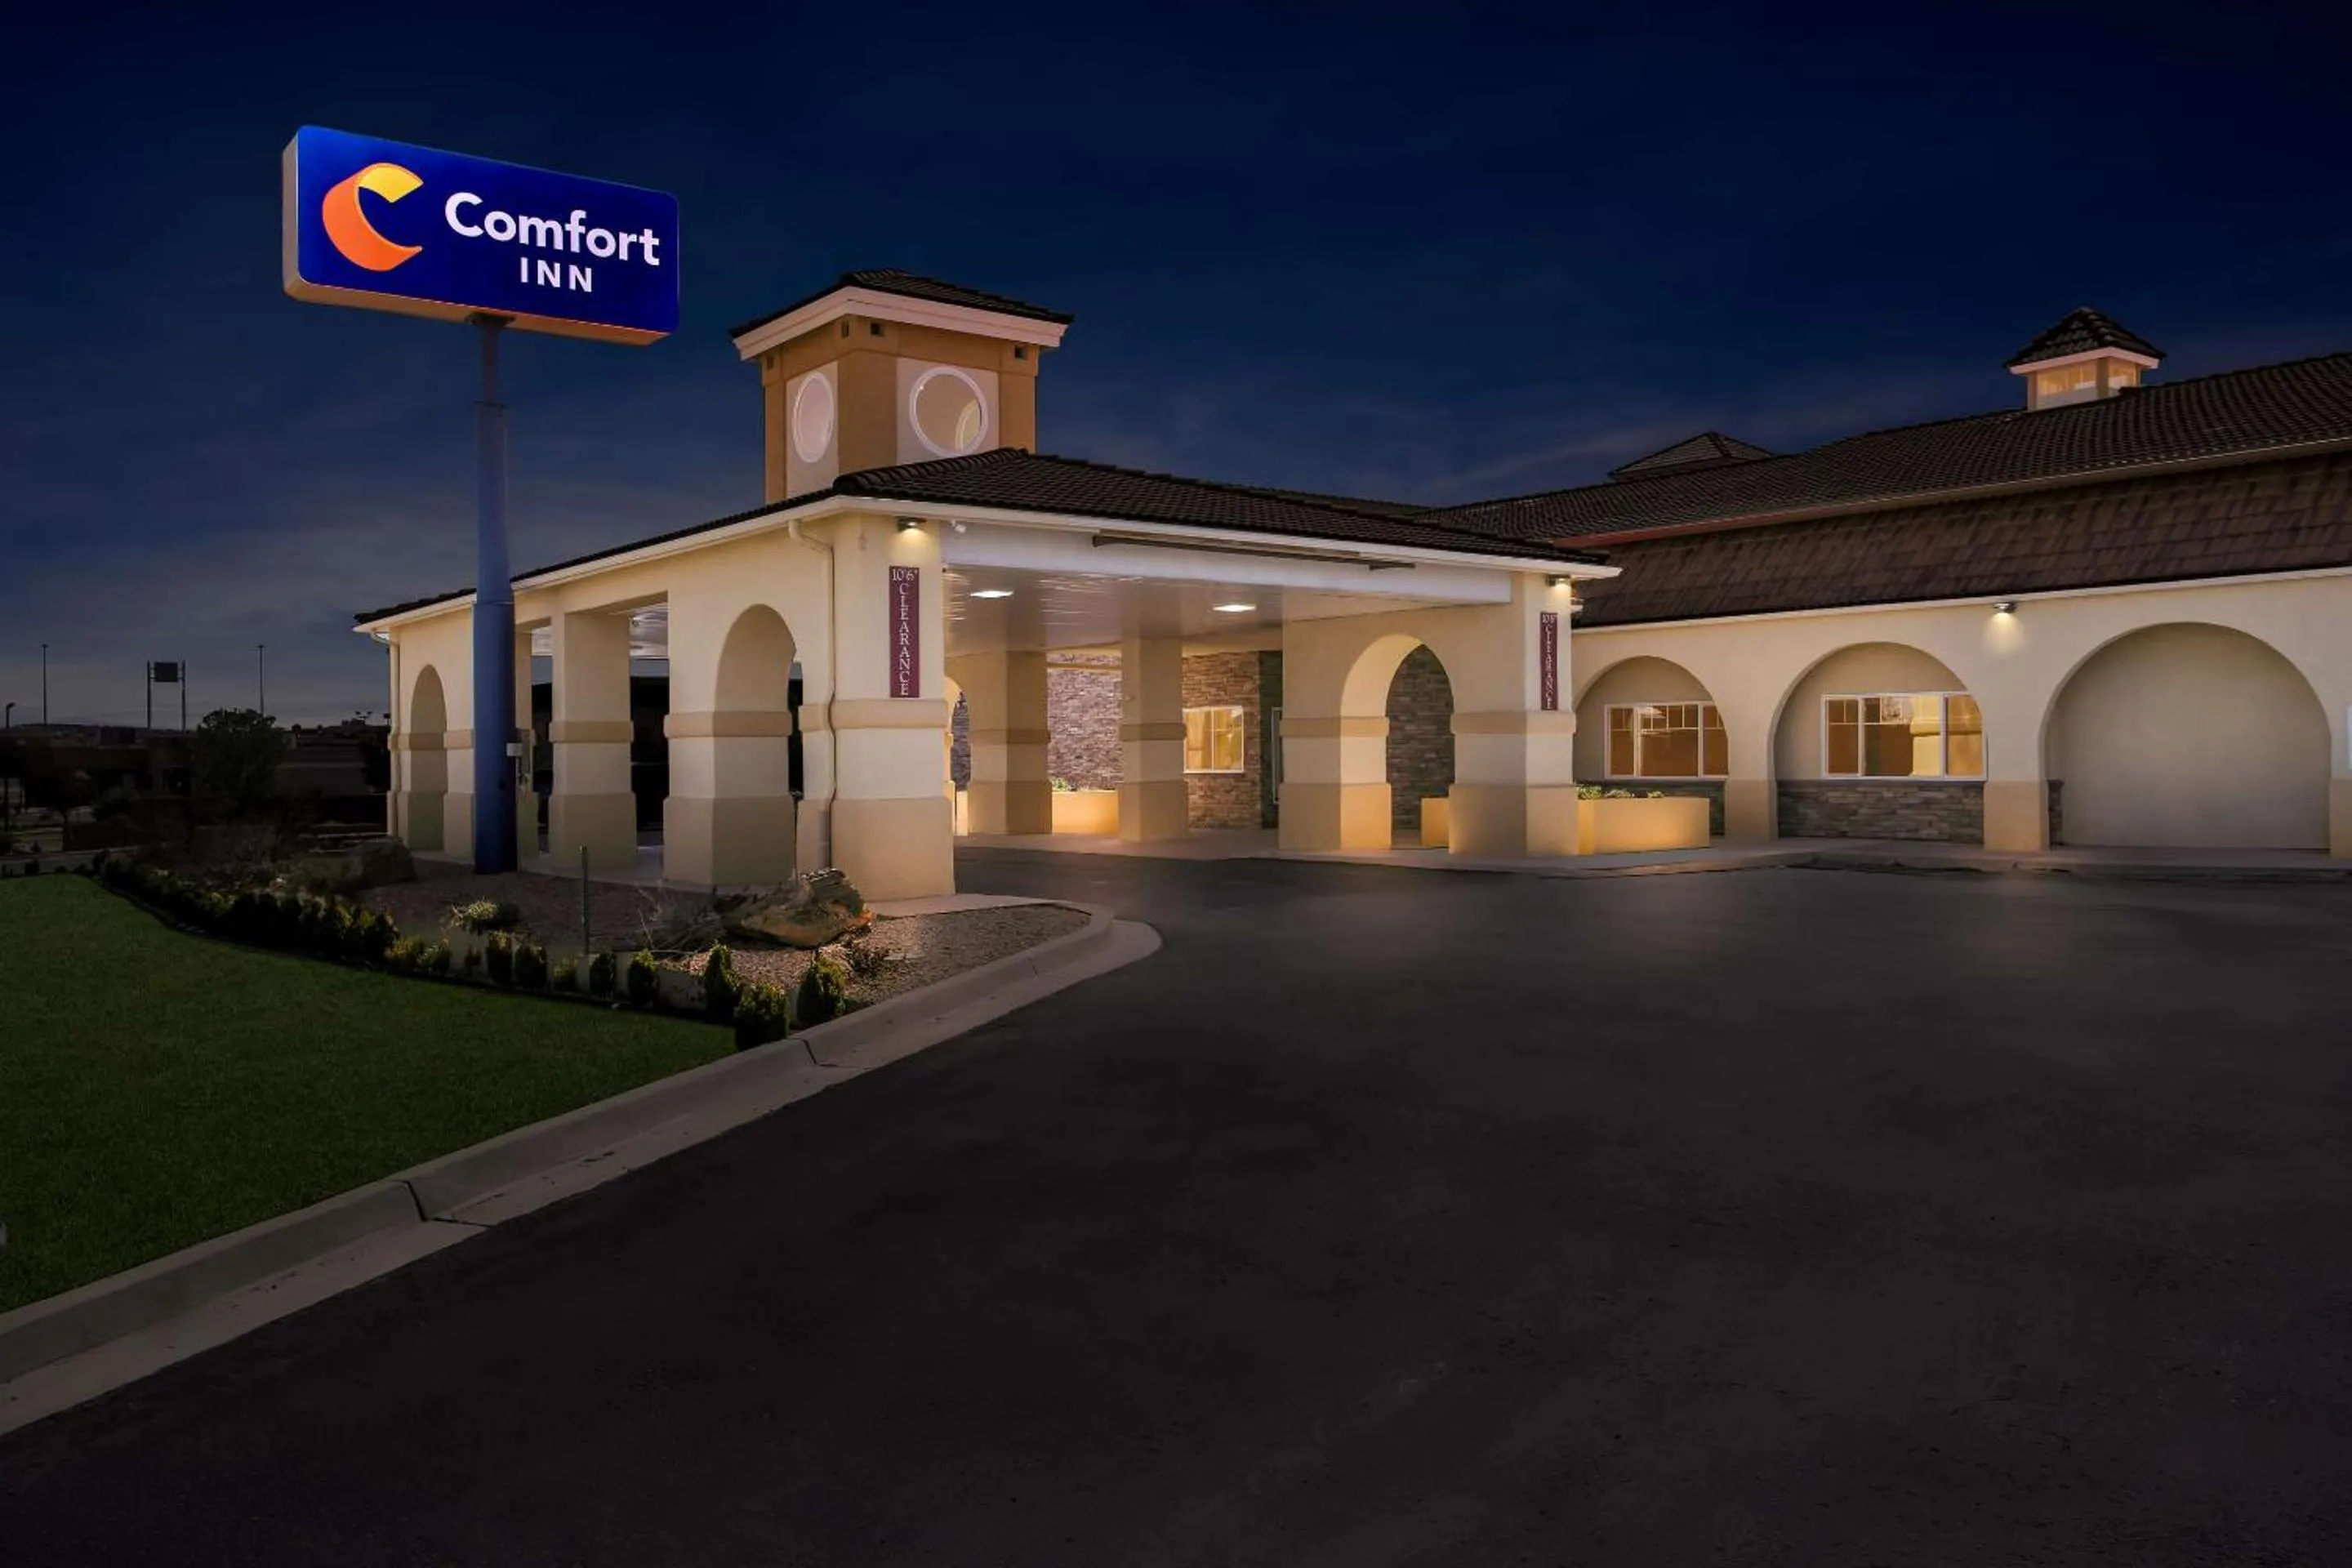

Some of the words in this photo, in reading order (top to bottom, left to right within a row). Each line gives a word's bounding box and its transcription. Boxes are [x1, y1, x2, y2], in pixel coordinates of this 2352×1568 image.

[444, 192, 660, 265] Comfort
[520, 256, 592, 292] INN
[898, 582, 911, 696] CLEARANCE
